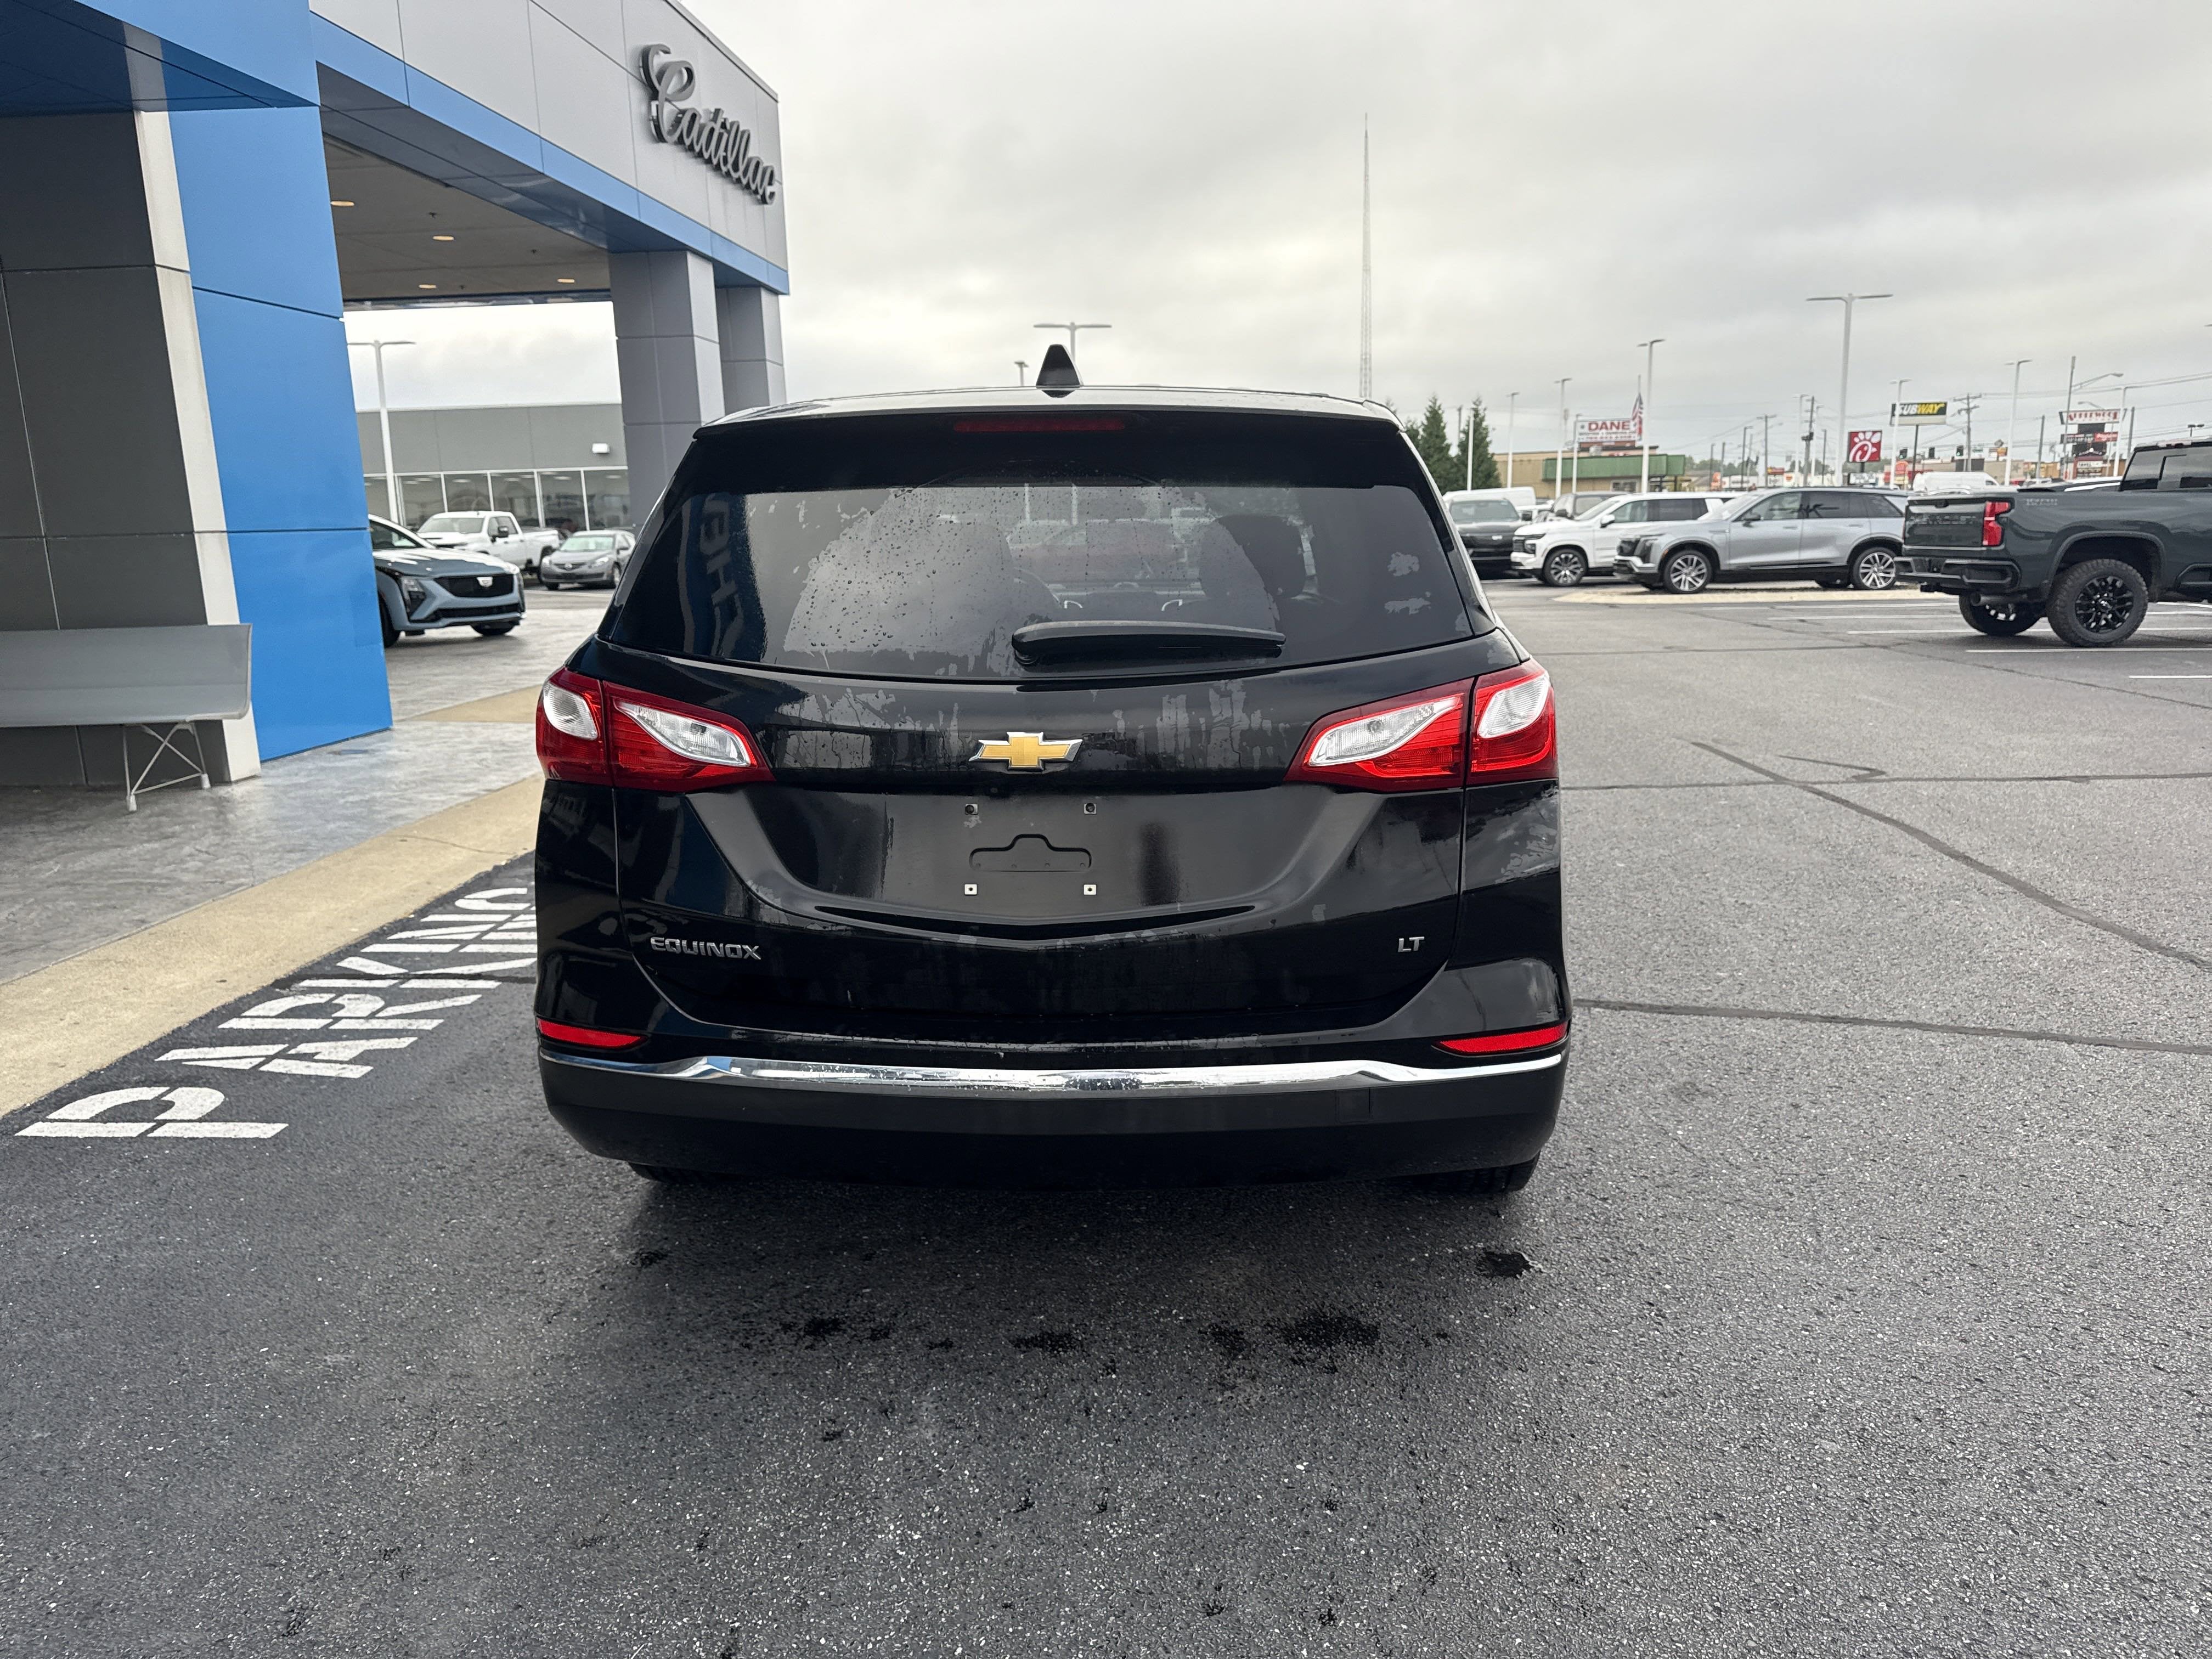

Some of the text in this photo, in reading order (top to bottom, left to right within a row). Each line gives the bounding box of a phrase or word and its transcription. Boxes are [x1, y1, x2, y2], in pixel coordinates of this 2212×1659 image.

[641, 44, 776, 205] Cadillac
[1895, 403, 1945, 415] SUBWAY
[1588, 421, 1630, 431] DANE
[650, 936, 761, 960] EQUINOX
[1398, 936, 1425, 952] LT
